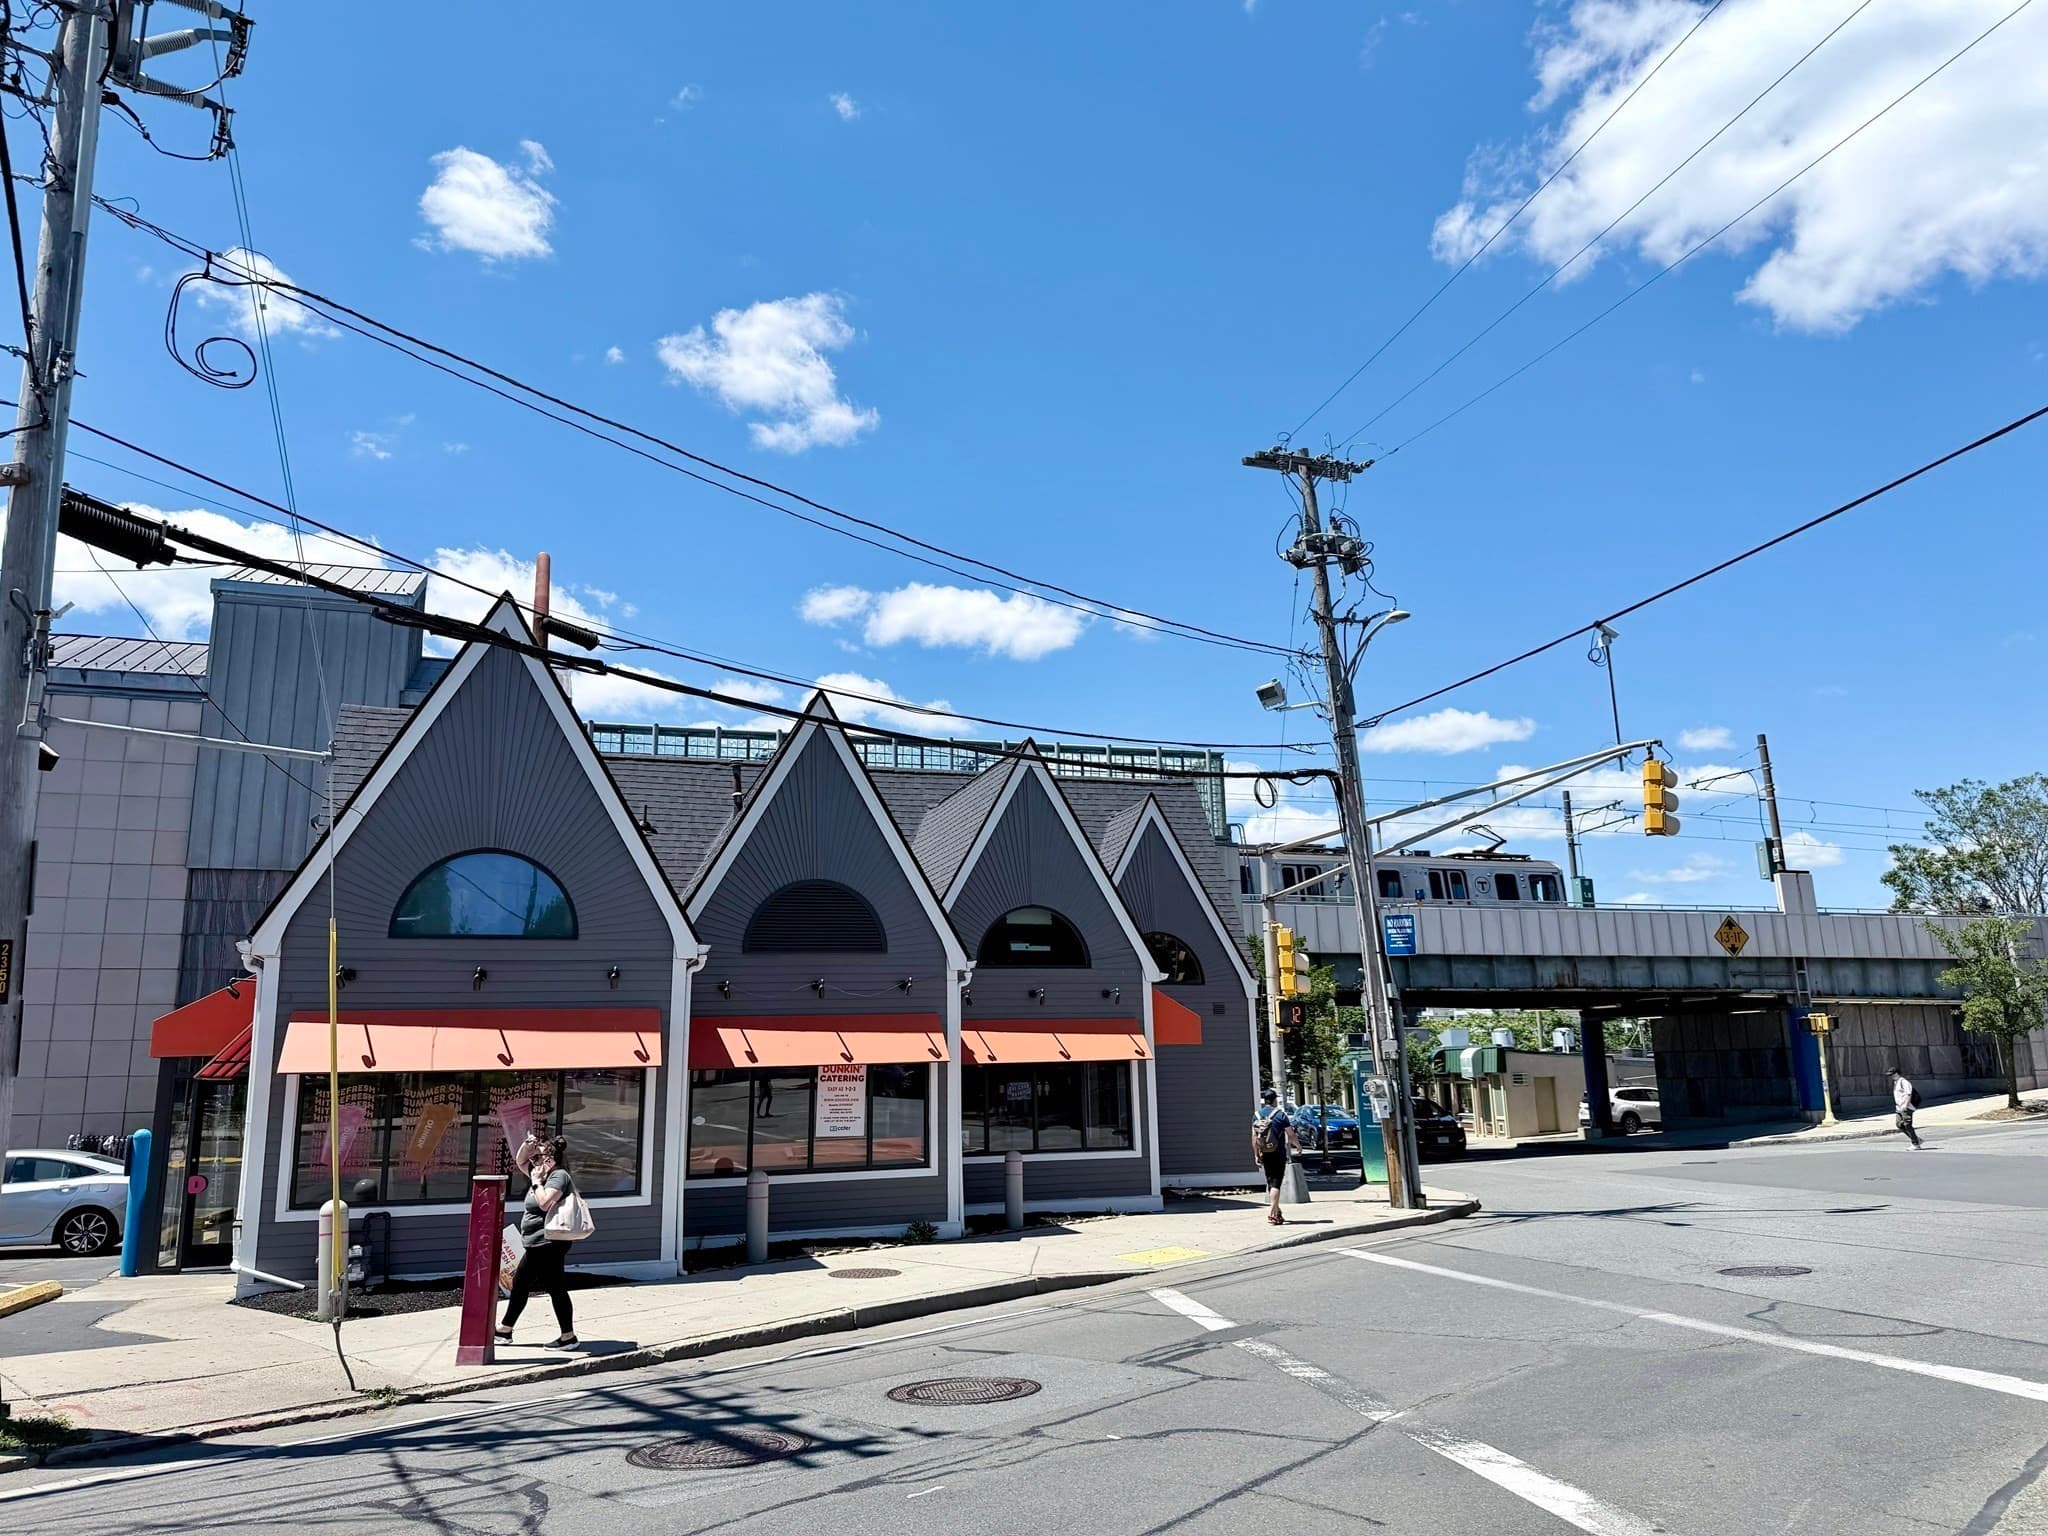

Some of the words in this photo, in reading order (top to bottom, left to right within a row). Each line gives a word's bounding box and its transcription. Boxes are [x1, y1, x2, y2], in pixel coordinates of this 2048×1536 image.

[1477, 881, 1487, 891] T
[822, 1064, 862, 1074] DUNKIN'
[316, 1088, 331, 1098] HIT
[338, 1084, 376, 1096] EFRESH
[404, 1085, 446, 1099] SUMMER
[448, 1084, 463, 1094] ON
[489, 1086, 506, 1097] MIX
[508, 1082, 532, 1095] YOUR
[315, 1097, 330, 1106] HIT
[338, 1092, 375, 1104] EFRESH
[447, 1093, 462, 1103] ON
[314, 1105, 330, 1114] HIT
[313, 1113, 329, 1122] HIT
[504, 1245, 516, 1261] AND
